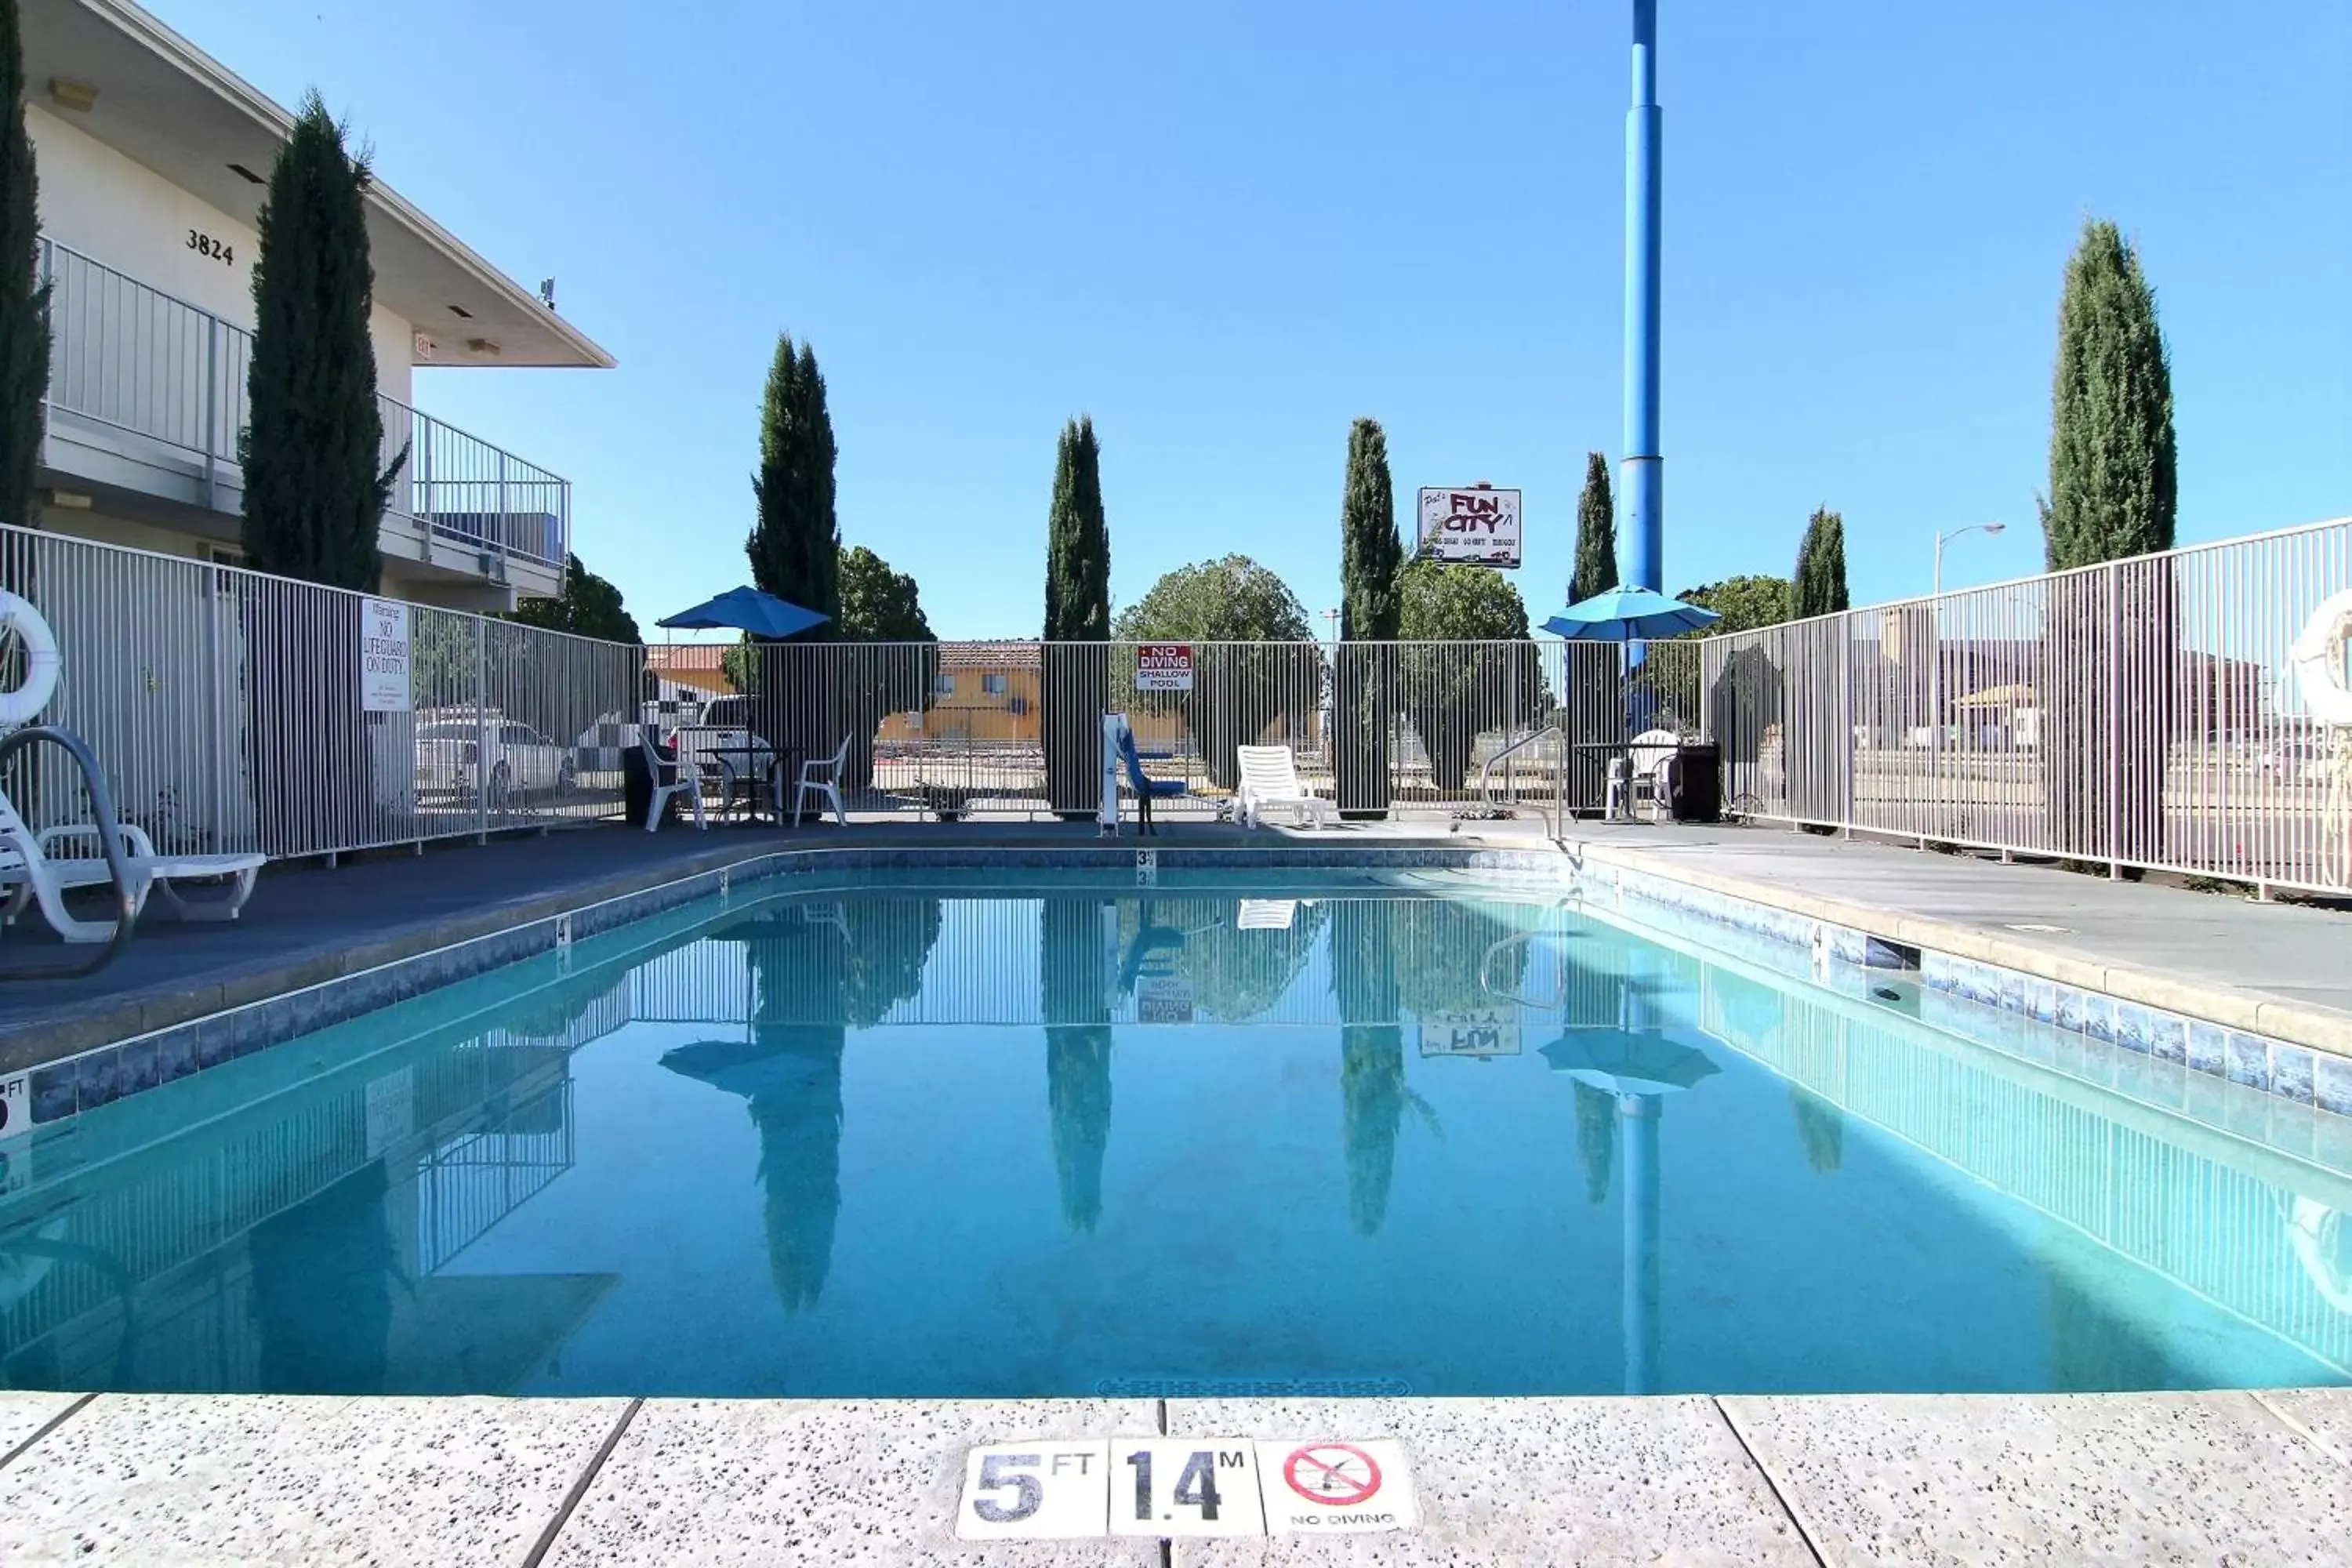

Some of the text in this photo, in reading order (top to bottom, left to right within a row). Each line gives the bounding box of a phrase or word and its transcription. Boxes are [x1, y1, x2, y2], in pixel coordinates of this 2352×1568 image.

[186, 229, 234, 266] 3824
[1450, 493, 1499, 515] FUN
[1443, 514, 1504, 534] CITY
[379, 620, 394, 638] NO
[363, 637, 407, 657] LIFEGUARD
[1152, 647, 1177, 656] NO
[366, 656, 380, 673] ON
[1141, 656, 1189, 667] DIVING
[1138, 850, 1147, 866] 3
[1813, 924, 1822, 949] 4
[9, 1078, 24, 1098] FT
[973, 1453, 1095, 1523] 5 FT
[1127, 1450, 1244, 1520] 1.4 M
[1290, 1513, 1396, 1525] NO DIVING
